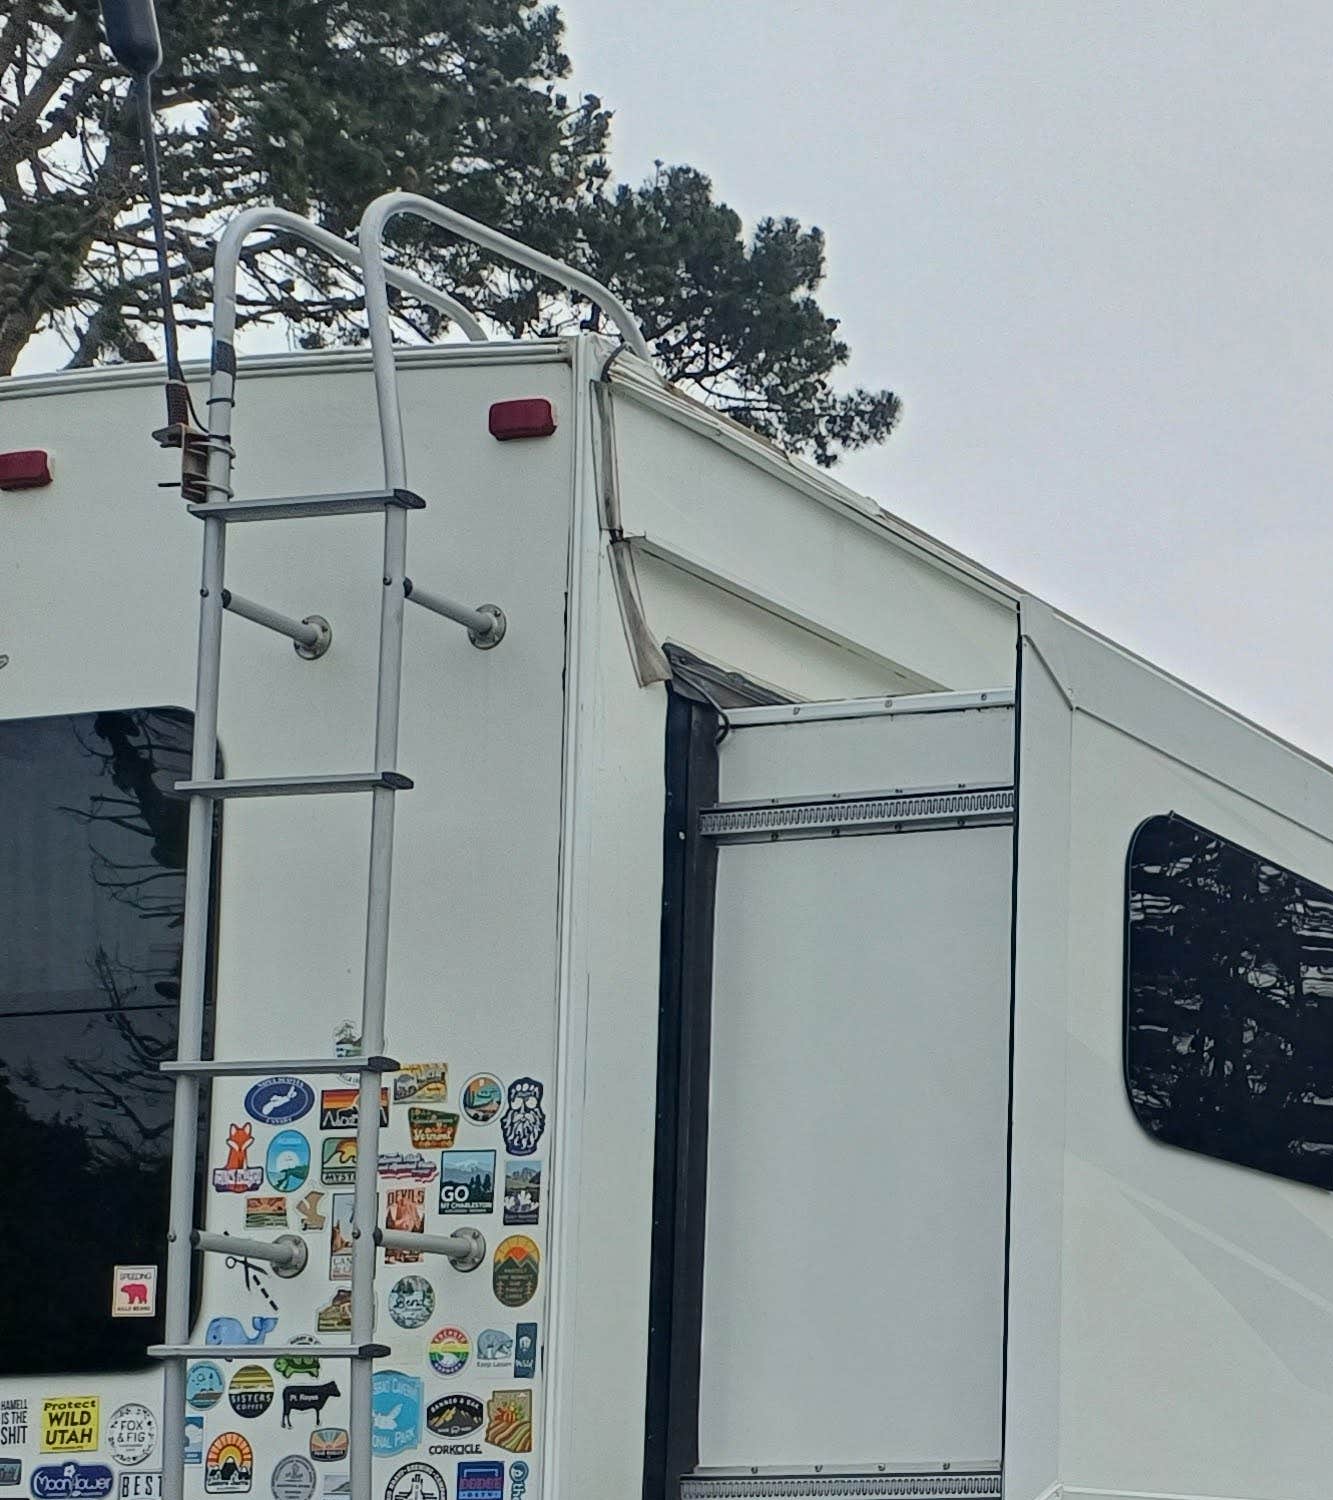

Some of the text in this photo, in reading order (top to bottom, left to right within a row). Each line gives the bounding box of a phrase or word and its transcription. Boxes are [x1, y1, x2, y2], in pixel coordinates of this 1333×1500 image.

[388, 1189, 425, 1206] DEVILS
[441, 1185, 469, 1202] GO
[44, 1400, 97, 1411] Protect
[231, 1393, 272, 1404] SISTERS
[1, 1411, 27, 1424] IS THE
[48, 1411, 92, 1426] WILD
[120, 1420, 143, 1431] FOX
[1, 1426, 28, 1445] SHIT
[45, 1428, 93, 1446] UTAH
[117, 1432, 146, 1443] & FIG
